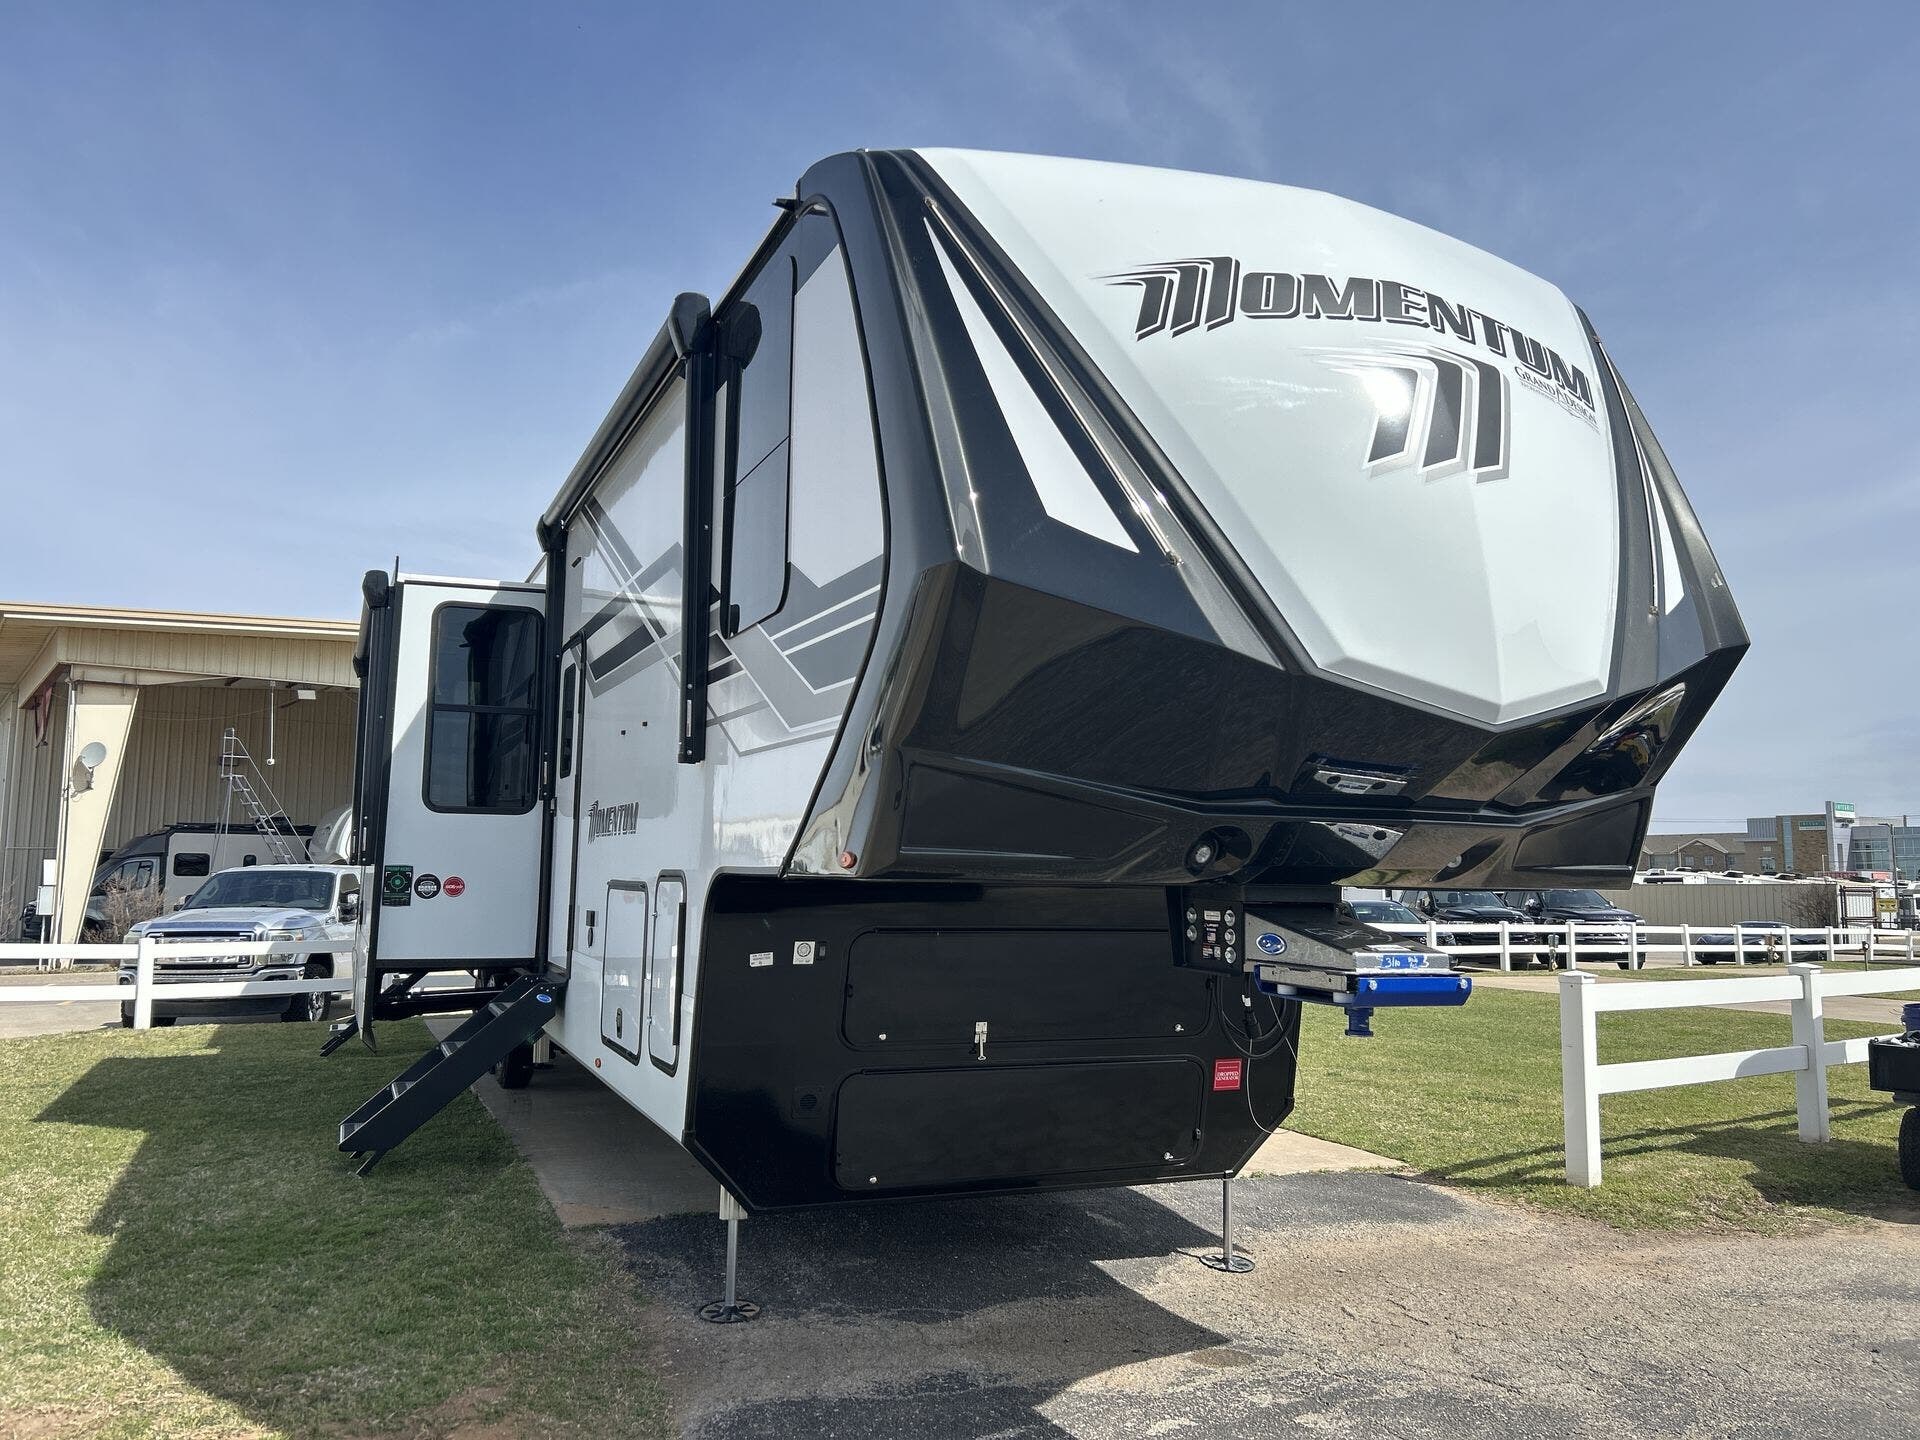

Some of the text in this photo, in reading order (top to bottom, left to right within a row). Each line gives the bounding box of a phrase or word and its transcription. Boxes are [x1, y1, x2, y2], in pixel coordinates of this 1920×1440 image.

[1093, 256, 1596, 413] MOMENTUM
[1514, 366, 1556, 397] GRAND
[588, 800, 639, 844] MOMENTUM
